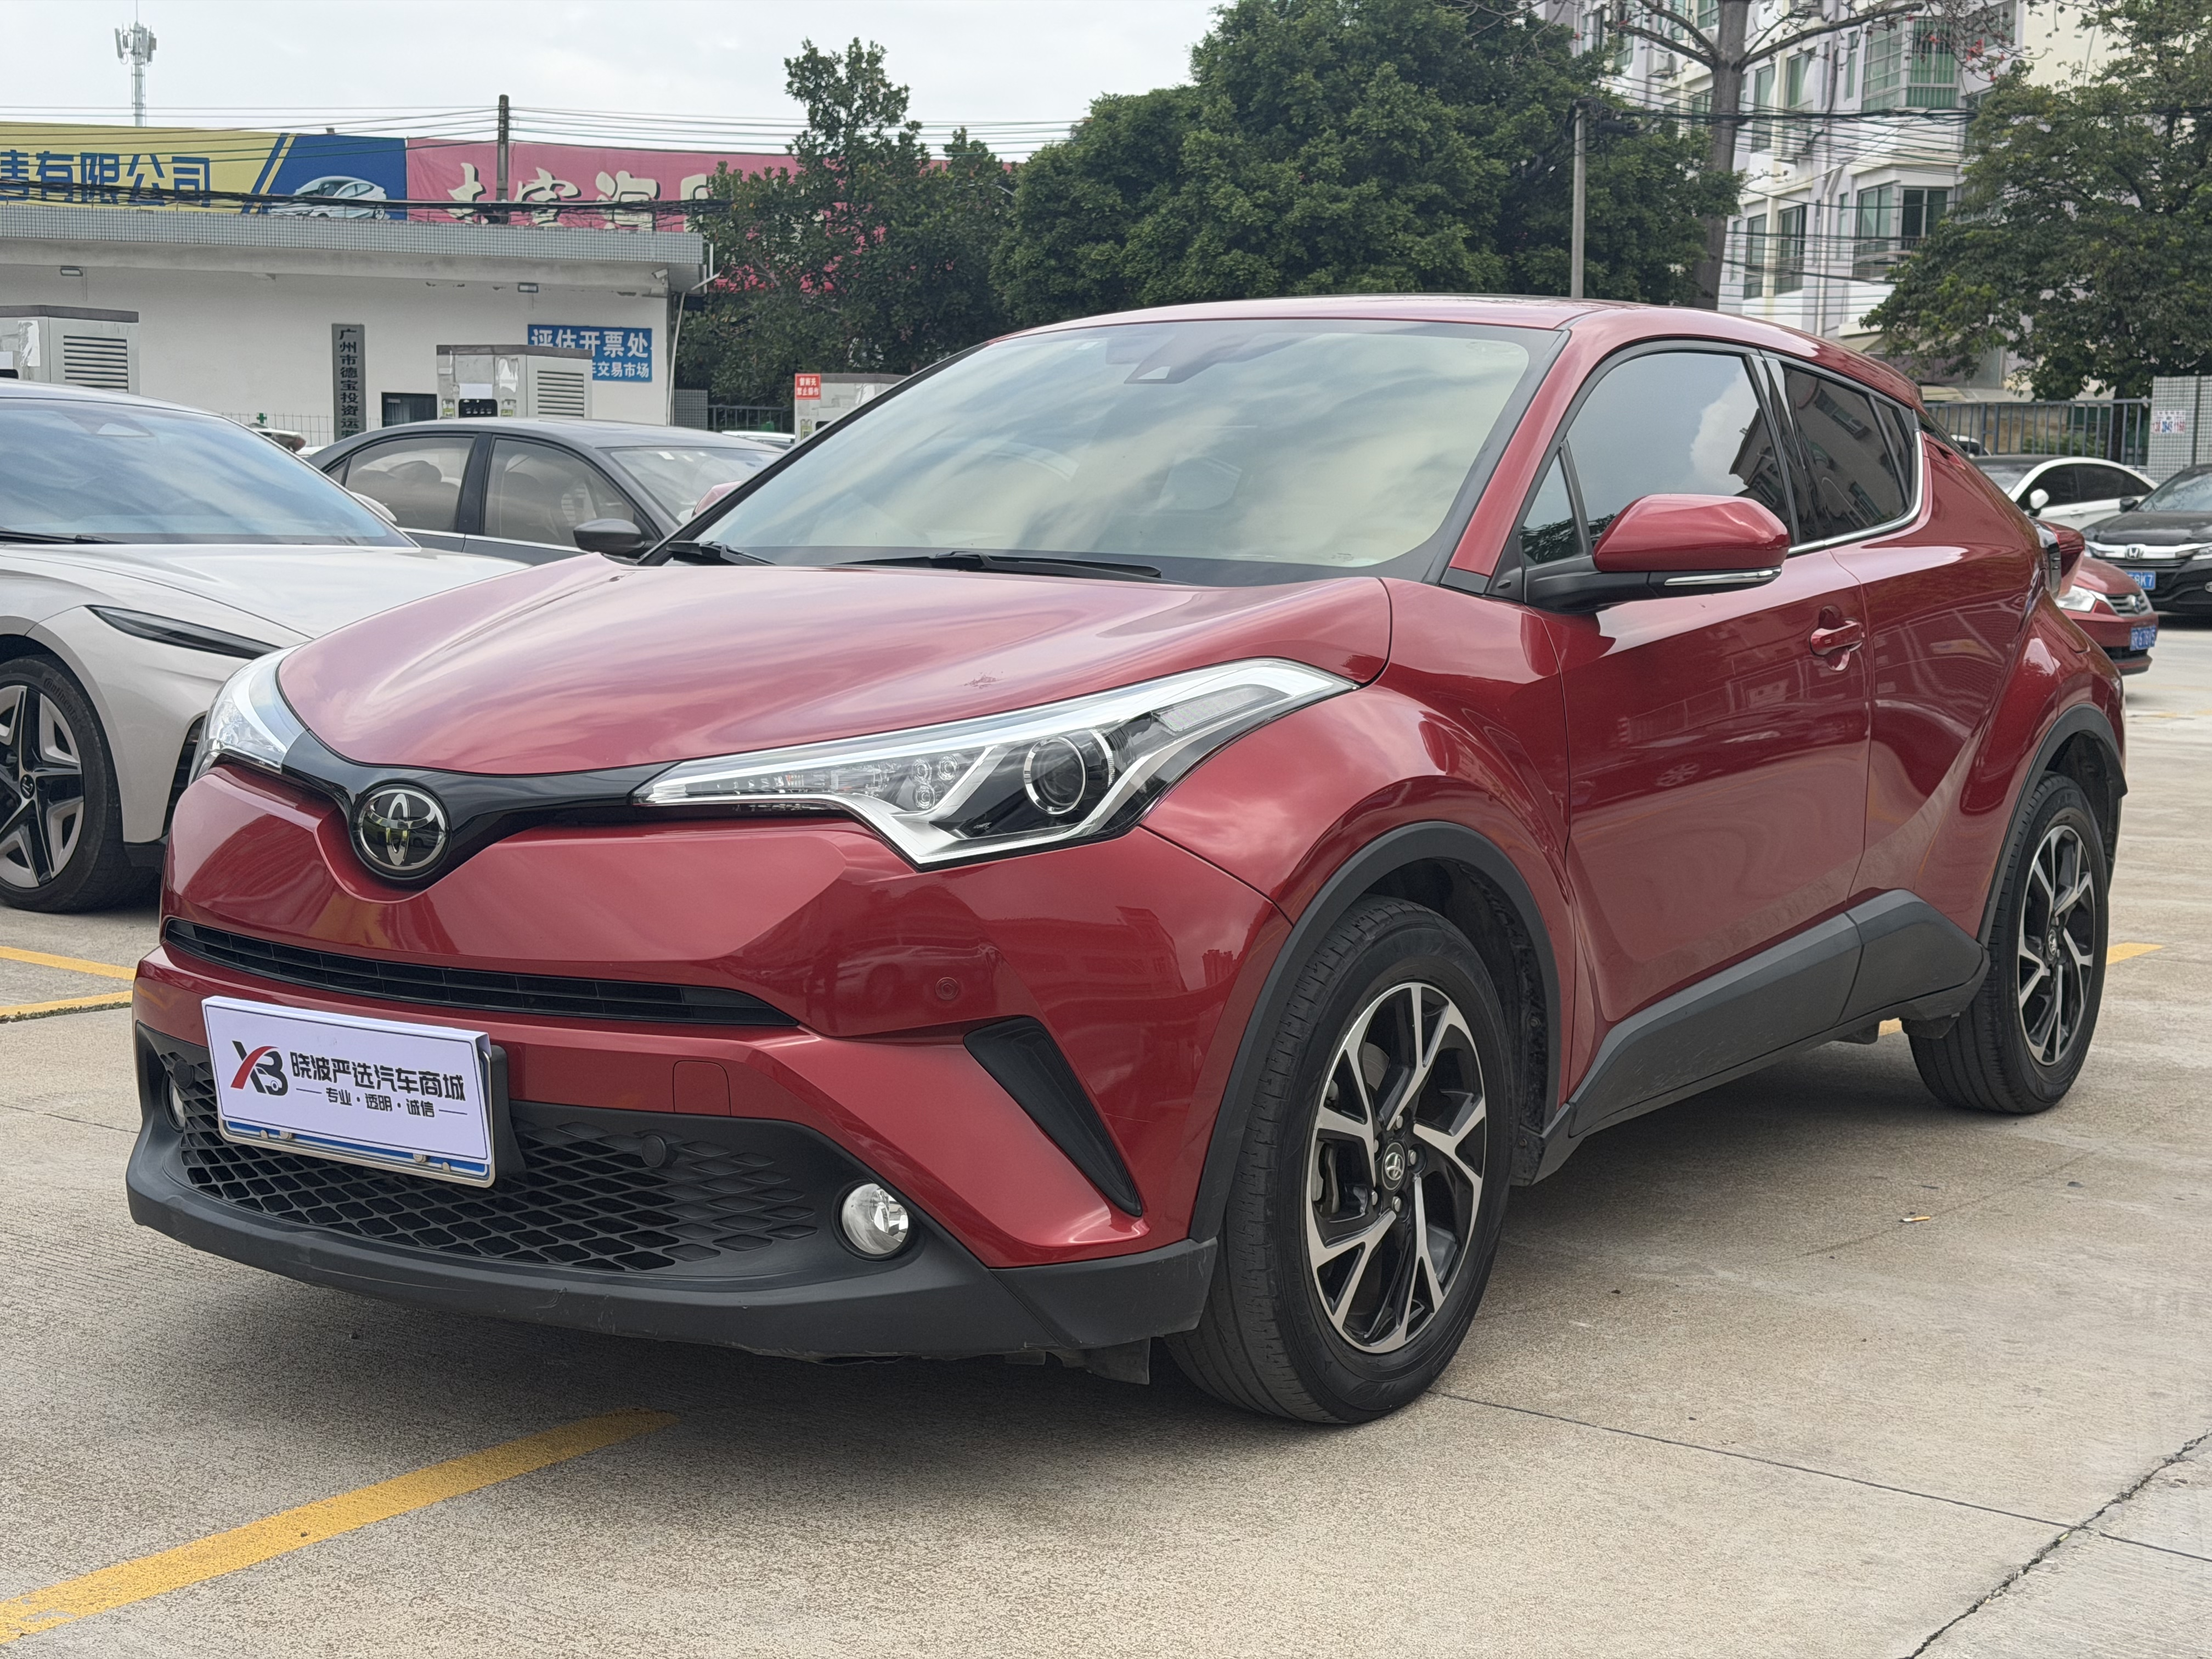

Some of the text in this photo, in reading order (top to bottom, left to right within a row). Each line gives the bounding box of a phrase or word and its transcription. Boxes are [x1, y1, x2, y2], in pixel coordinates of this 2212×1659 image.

[531, 329, 648, 358] 评估开票处
[290, 1051, 466, 1101] 晓波严选汽车商城
